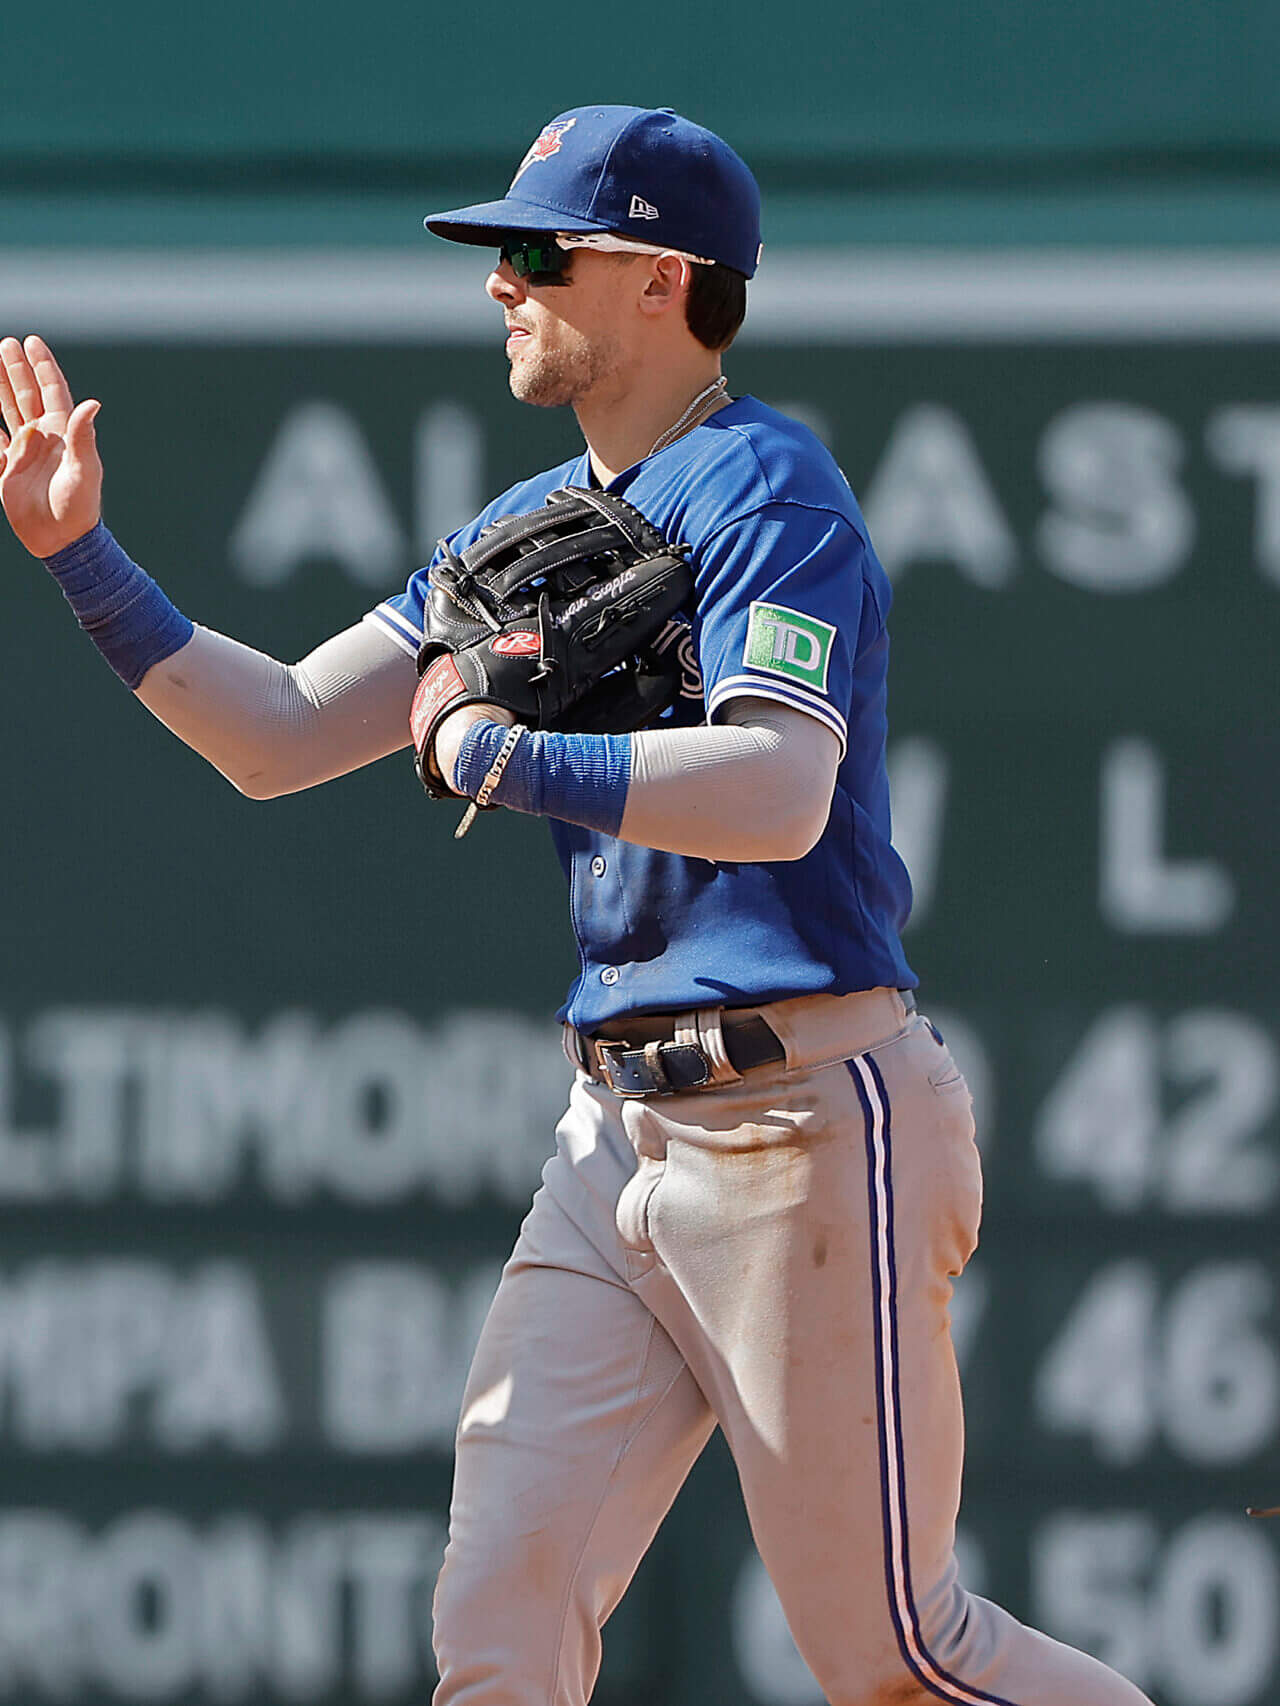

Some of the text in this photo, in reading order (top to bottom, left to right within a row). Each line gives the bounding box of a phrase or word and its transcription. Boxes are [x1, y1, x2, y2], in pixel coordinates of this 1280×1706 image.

[762, 620, 821, 671] TD
[1100, 738, 1237, 935] L
[1045, 1010, 1280, 1210] 42
[1040, 1268, 1280, 1465] 46
[1040, 1518, 1280, 1706] 50
